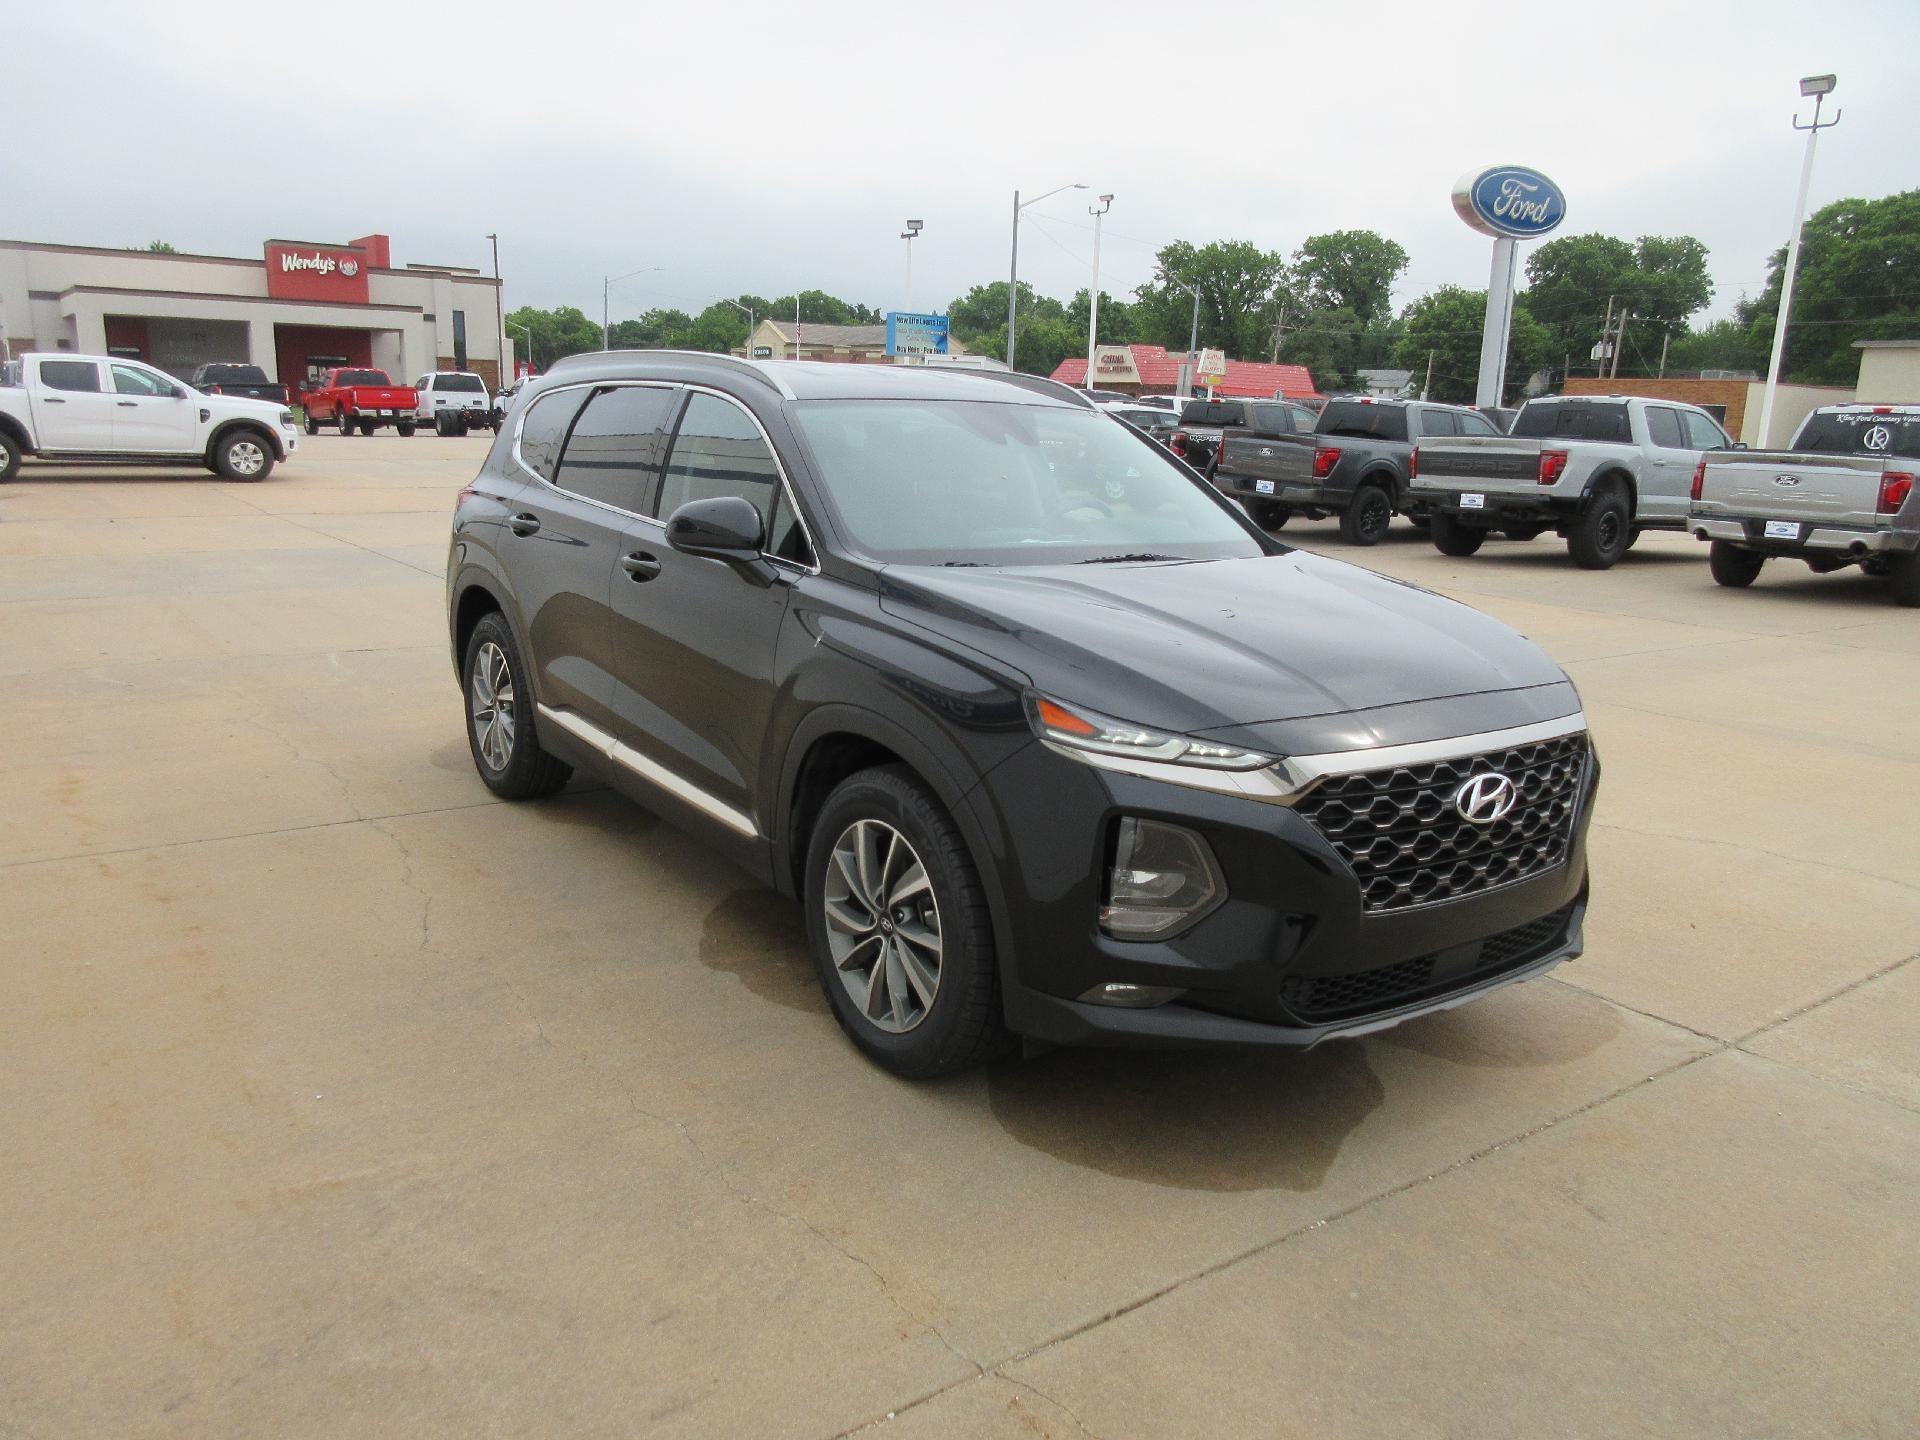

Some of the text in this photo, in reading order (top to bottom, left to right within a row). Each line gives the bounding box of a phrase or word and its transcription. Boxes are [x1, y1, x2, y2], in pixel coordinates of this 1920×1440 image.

[1493, 179, 1551, 223] Ford
[282, 252, 336, 275] Wendy's
[1836, 414, 1855, 423] Kline
[1872, 415, 1901, 424] Courtesy
